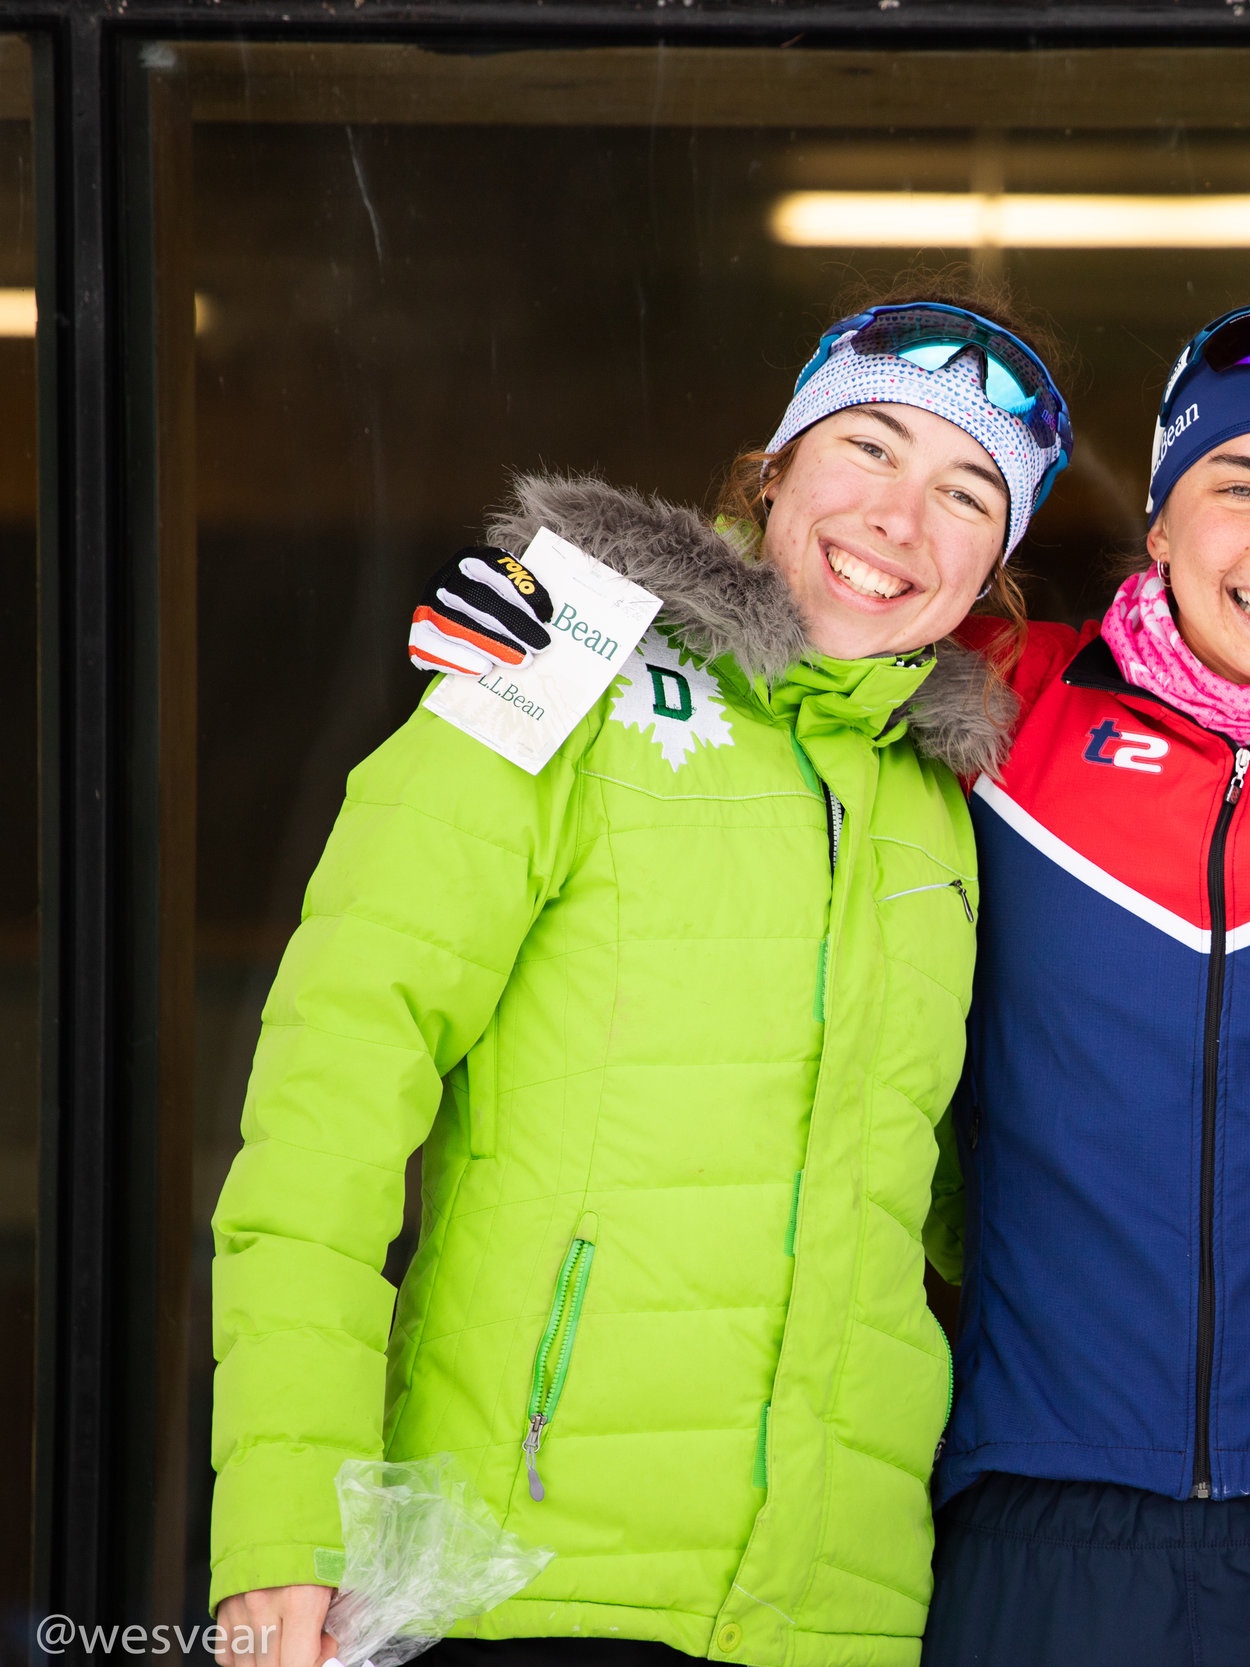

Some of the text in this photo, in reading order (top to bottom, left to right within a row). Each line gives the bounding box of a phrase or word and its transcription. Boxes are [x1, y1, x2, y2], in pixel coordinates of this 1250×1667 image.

[496, 556, 536, 596] TOKO
[645, 663, 693, 722] D
[1082, 717, 1170, 774] t2
